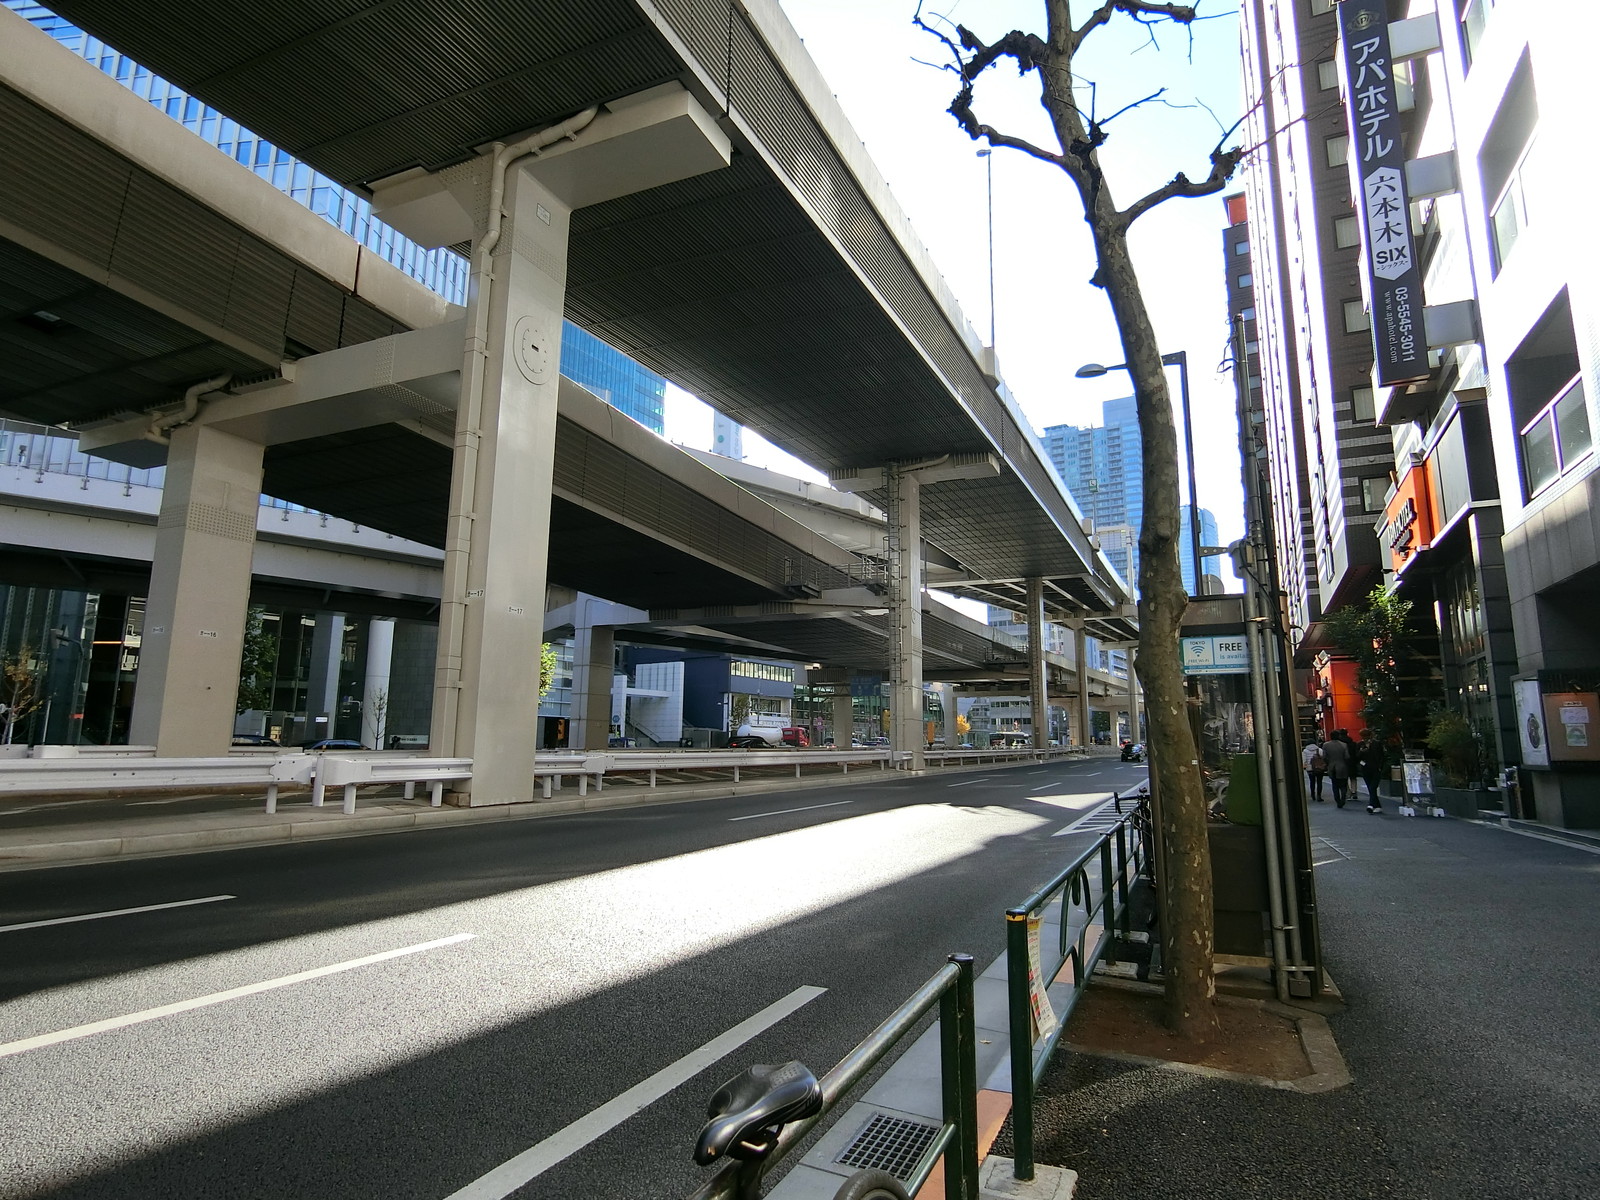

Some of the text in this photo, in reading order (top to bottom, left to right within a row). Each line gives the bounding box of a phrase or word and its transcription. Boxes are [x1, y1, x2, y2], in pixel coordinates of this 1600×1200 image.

[1352, 37, 1393, 161] アパホテル
[1369, 175, 1403, 243] 六本木
[1376, 245, 1408, 265] SIX
[1384, 291, 1398, 363] www.apahotel.com
[1395, 286, 1415, 362] 03-5545-3011
[1219, 642, 1242, 651] FREE
